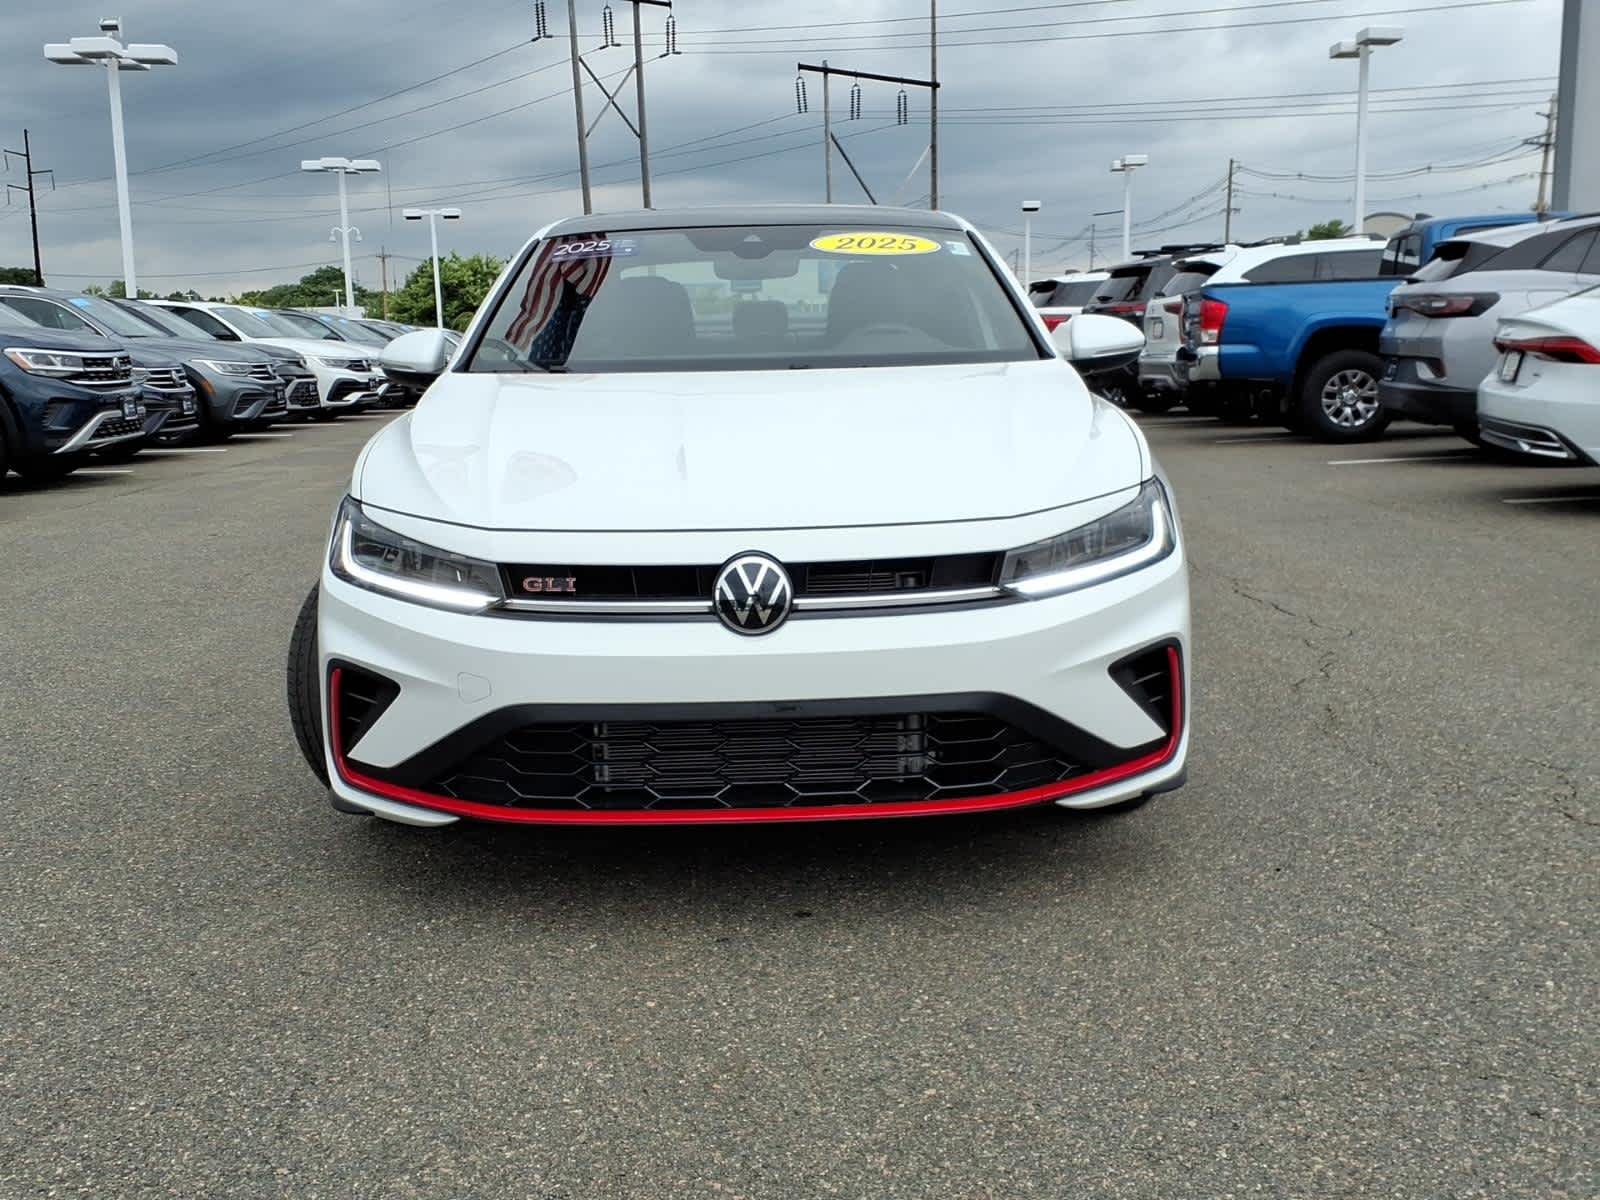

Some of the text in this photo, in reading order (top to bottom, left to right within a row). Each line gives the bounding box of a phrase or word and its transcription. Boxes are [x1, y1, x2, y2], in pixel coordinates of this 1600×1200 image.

[553, 240, 611, 256] 2025
[836, 237, 917, 251] 2025
[522, 577, 577, 592] GLI
[717, 556, 789, 628] VW
